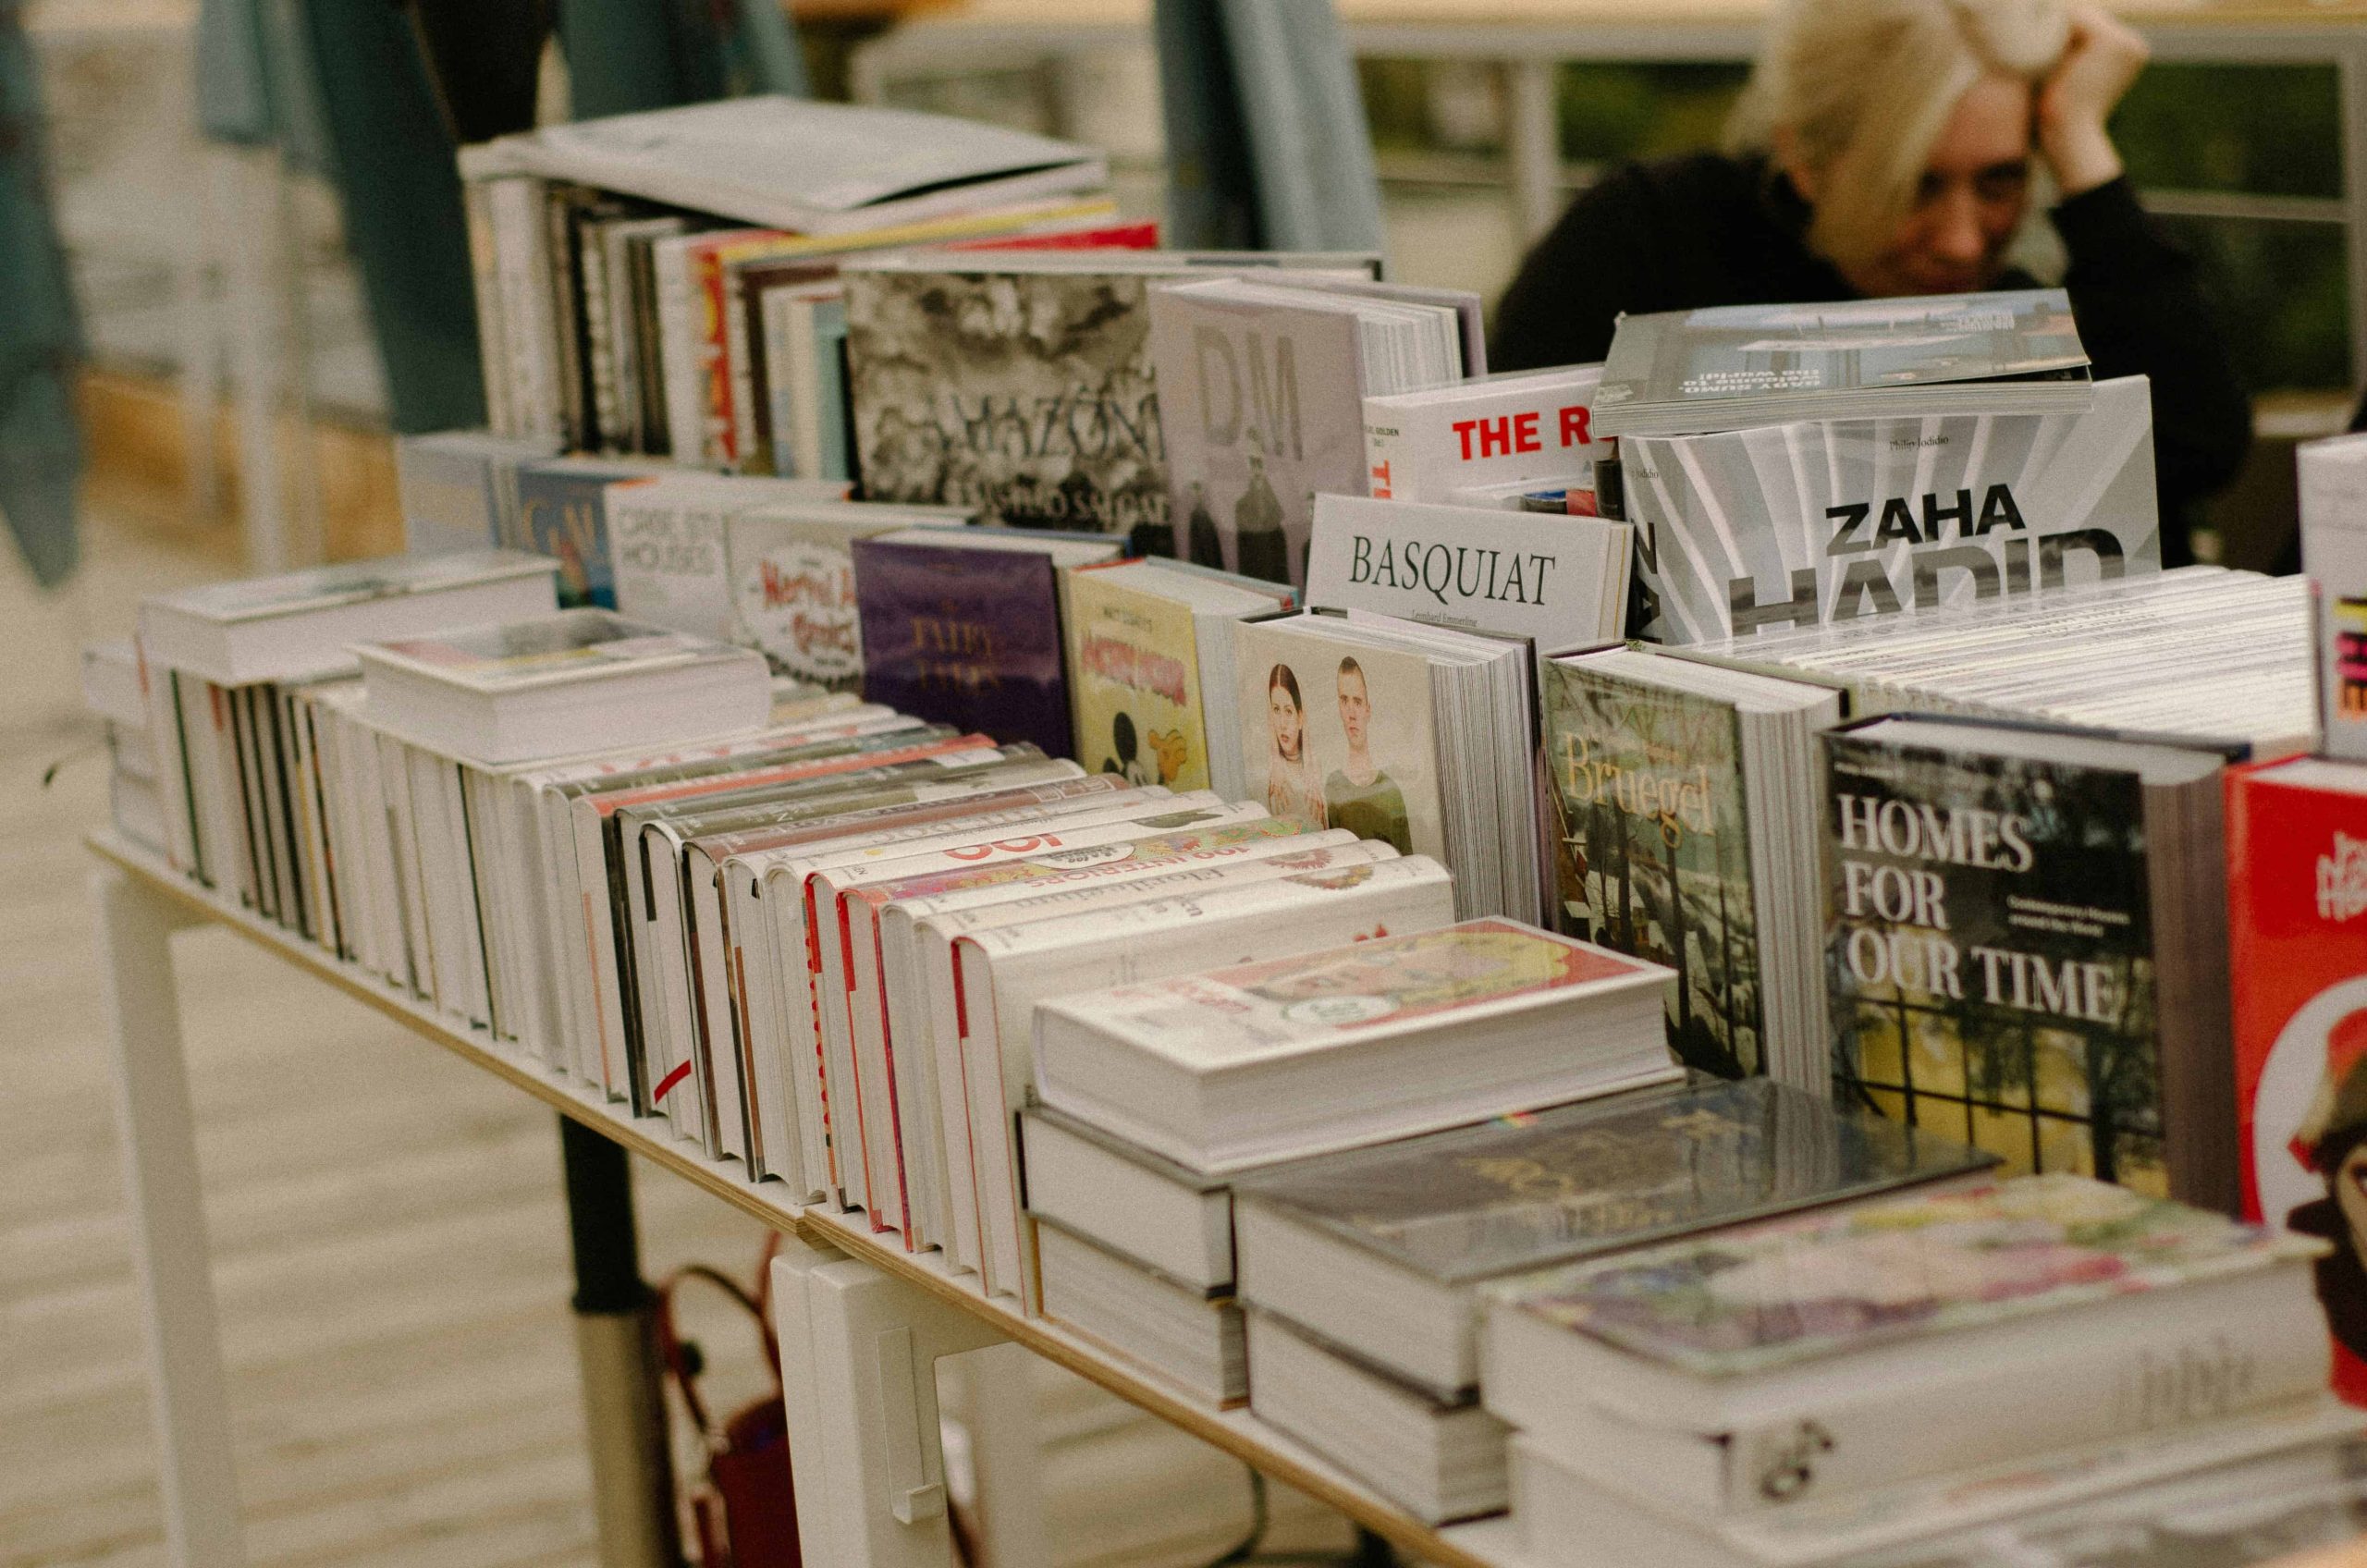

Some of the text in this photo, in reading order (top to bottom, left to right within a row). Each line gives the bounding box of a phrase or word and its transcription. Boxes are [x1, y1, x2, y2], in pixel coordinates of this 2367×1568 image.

[1452, 406, 1617, 460] THE R
[1890, 435, 1950, 452] Philip Jodidio
[1826, 484, 2027, 557] ZAHA
[1348, 535, 1555, 606] BASQUIAT
[1564, 730, 1717, 848] Bruegel
[943, 832, 1062, 862] 100
[1191, 844, 1249, 862] 100
[1837, 793, 2033, 873] HOMES
[1028, 855, 1187, 888] INTERIORS
[1843, 860, 1950, 931] FOR
[1846, 927, 2123, 1024] OUR TIME
